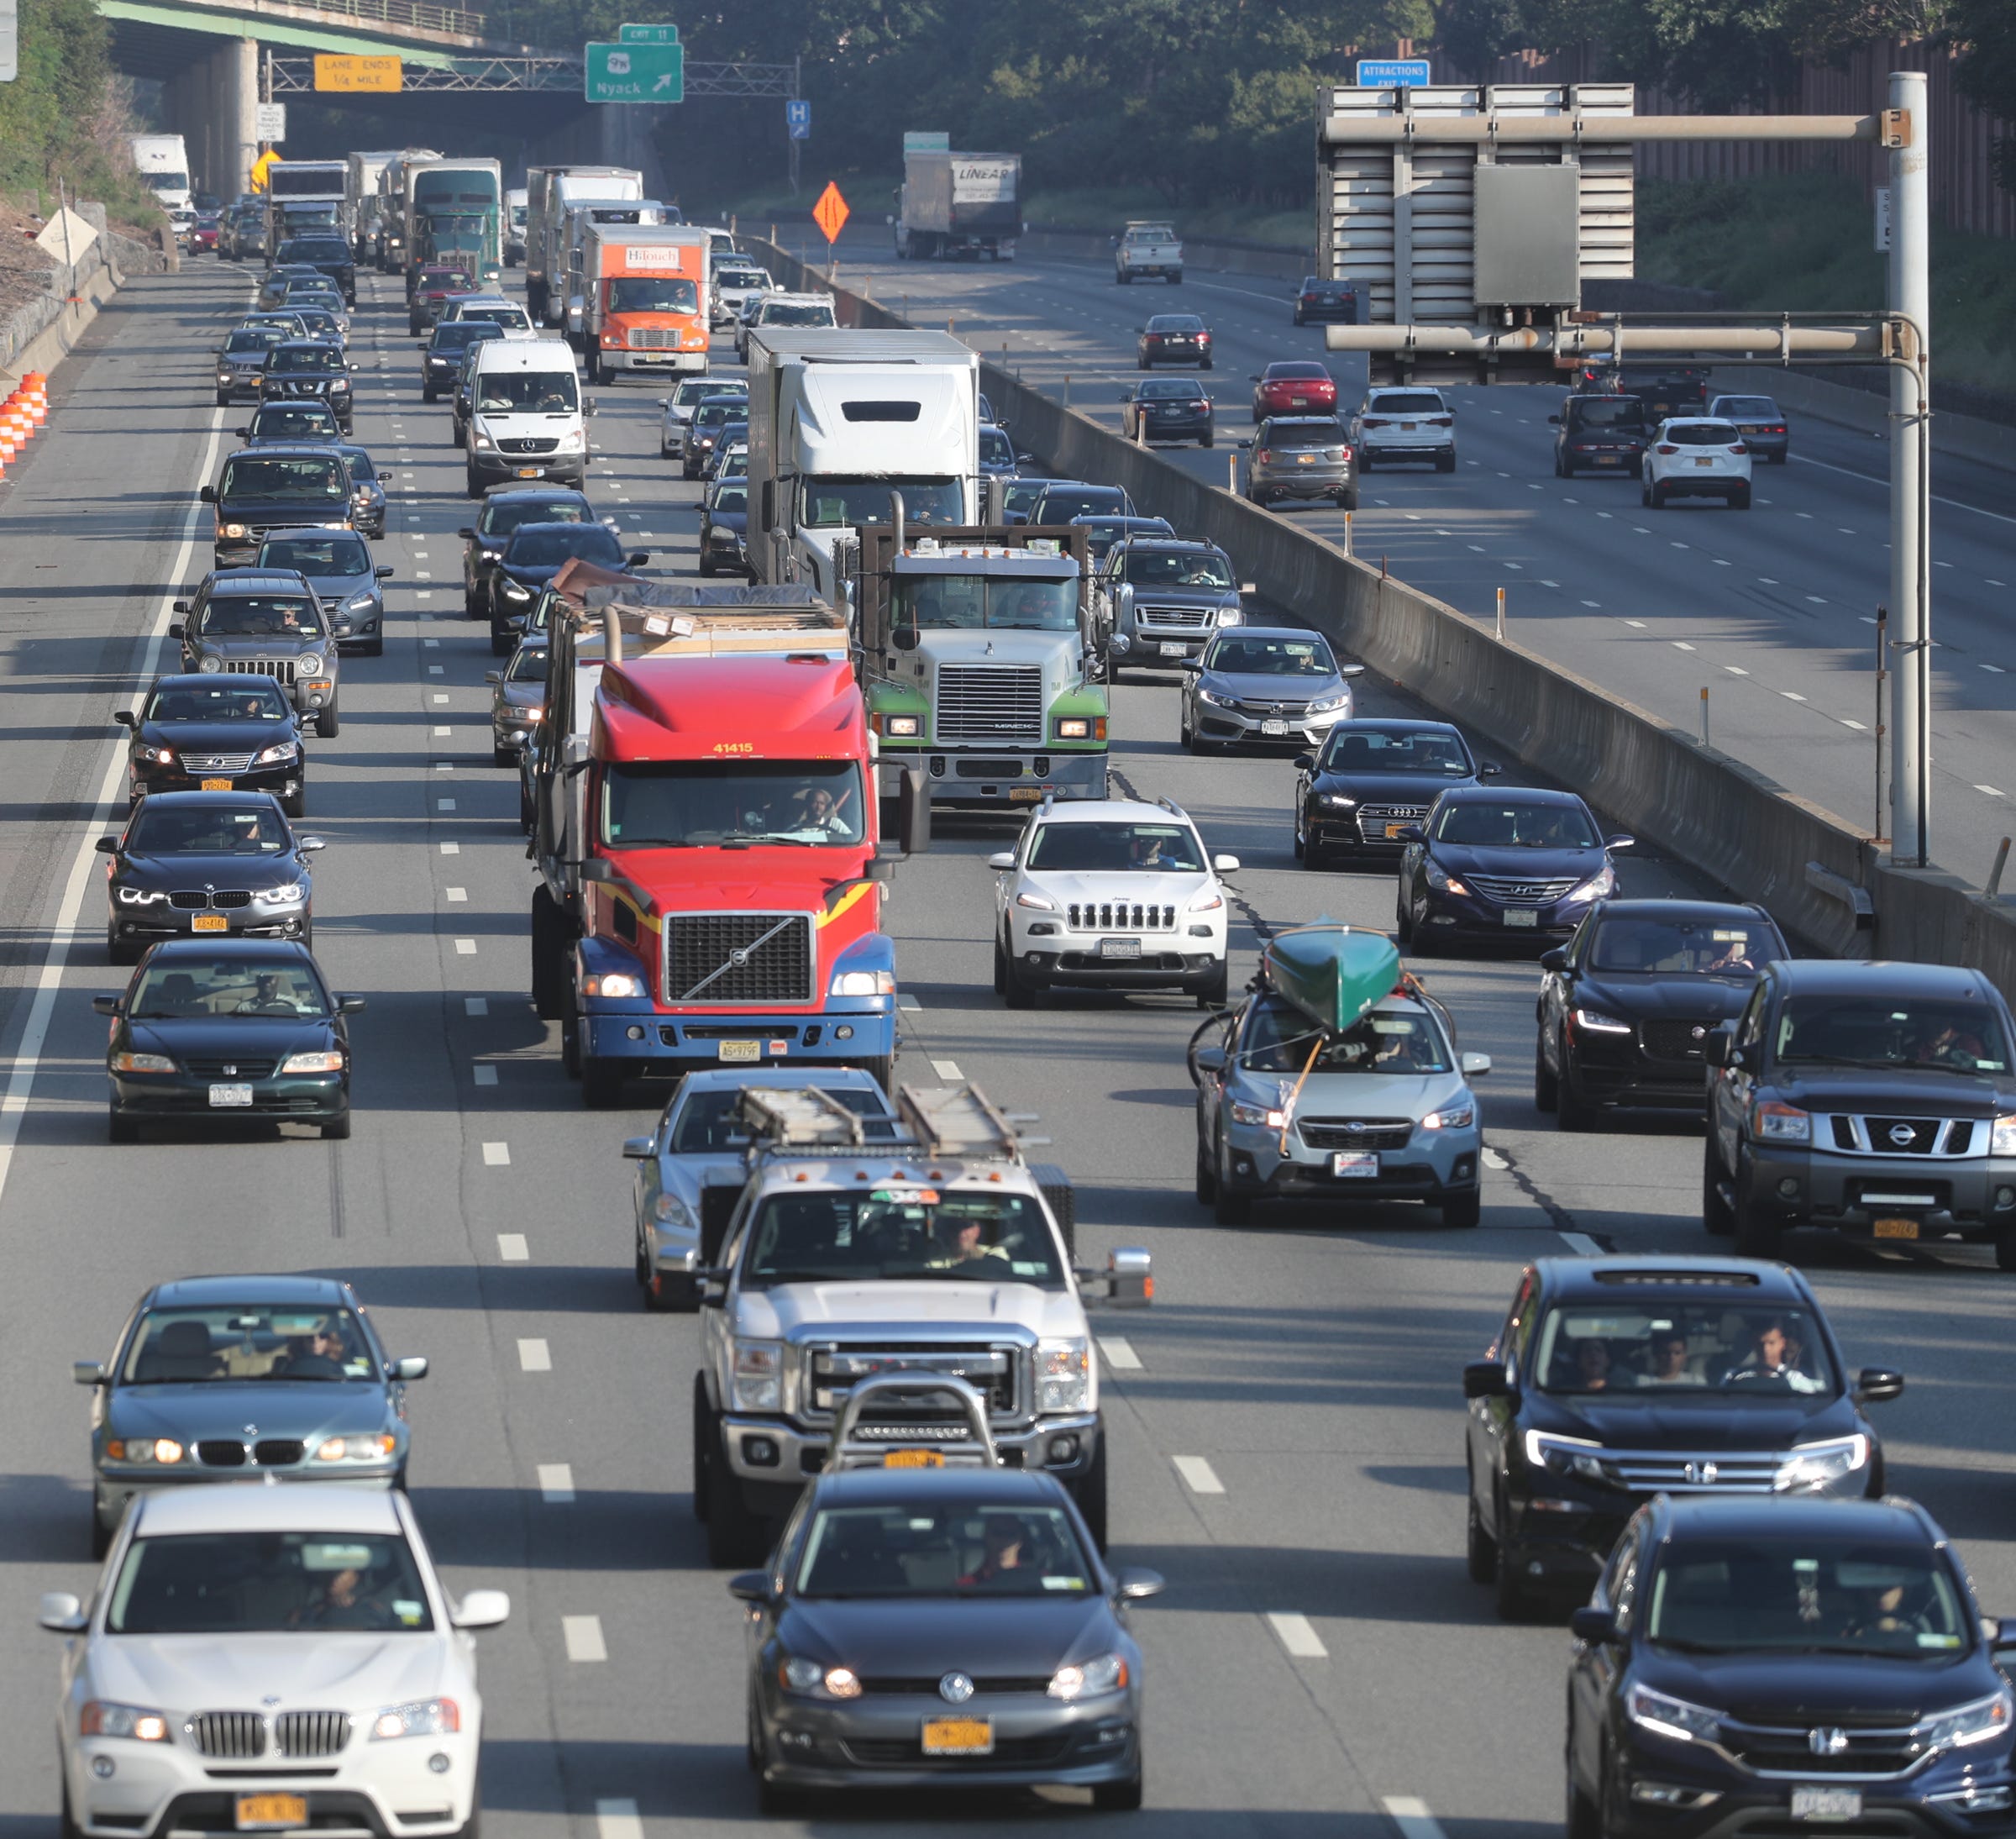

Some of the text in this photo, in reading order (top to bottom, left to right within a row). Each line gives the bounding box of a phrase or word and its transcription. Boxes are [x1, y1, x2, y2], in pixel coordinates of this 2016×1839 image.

[324, 60, 391, 70] LANE ENDS
[1363, 66, 1424, 76] ATTRACTIONS
[357, 75, 381, 84] MILE
[597, 81, 641, 96] Nyack
[791, 104, 805, 121] H
[959, 168, 1008, 180] LINEAR
[628, 250, 676, 261] HiTouch
[713, 743, 753, 754] 41415
